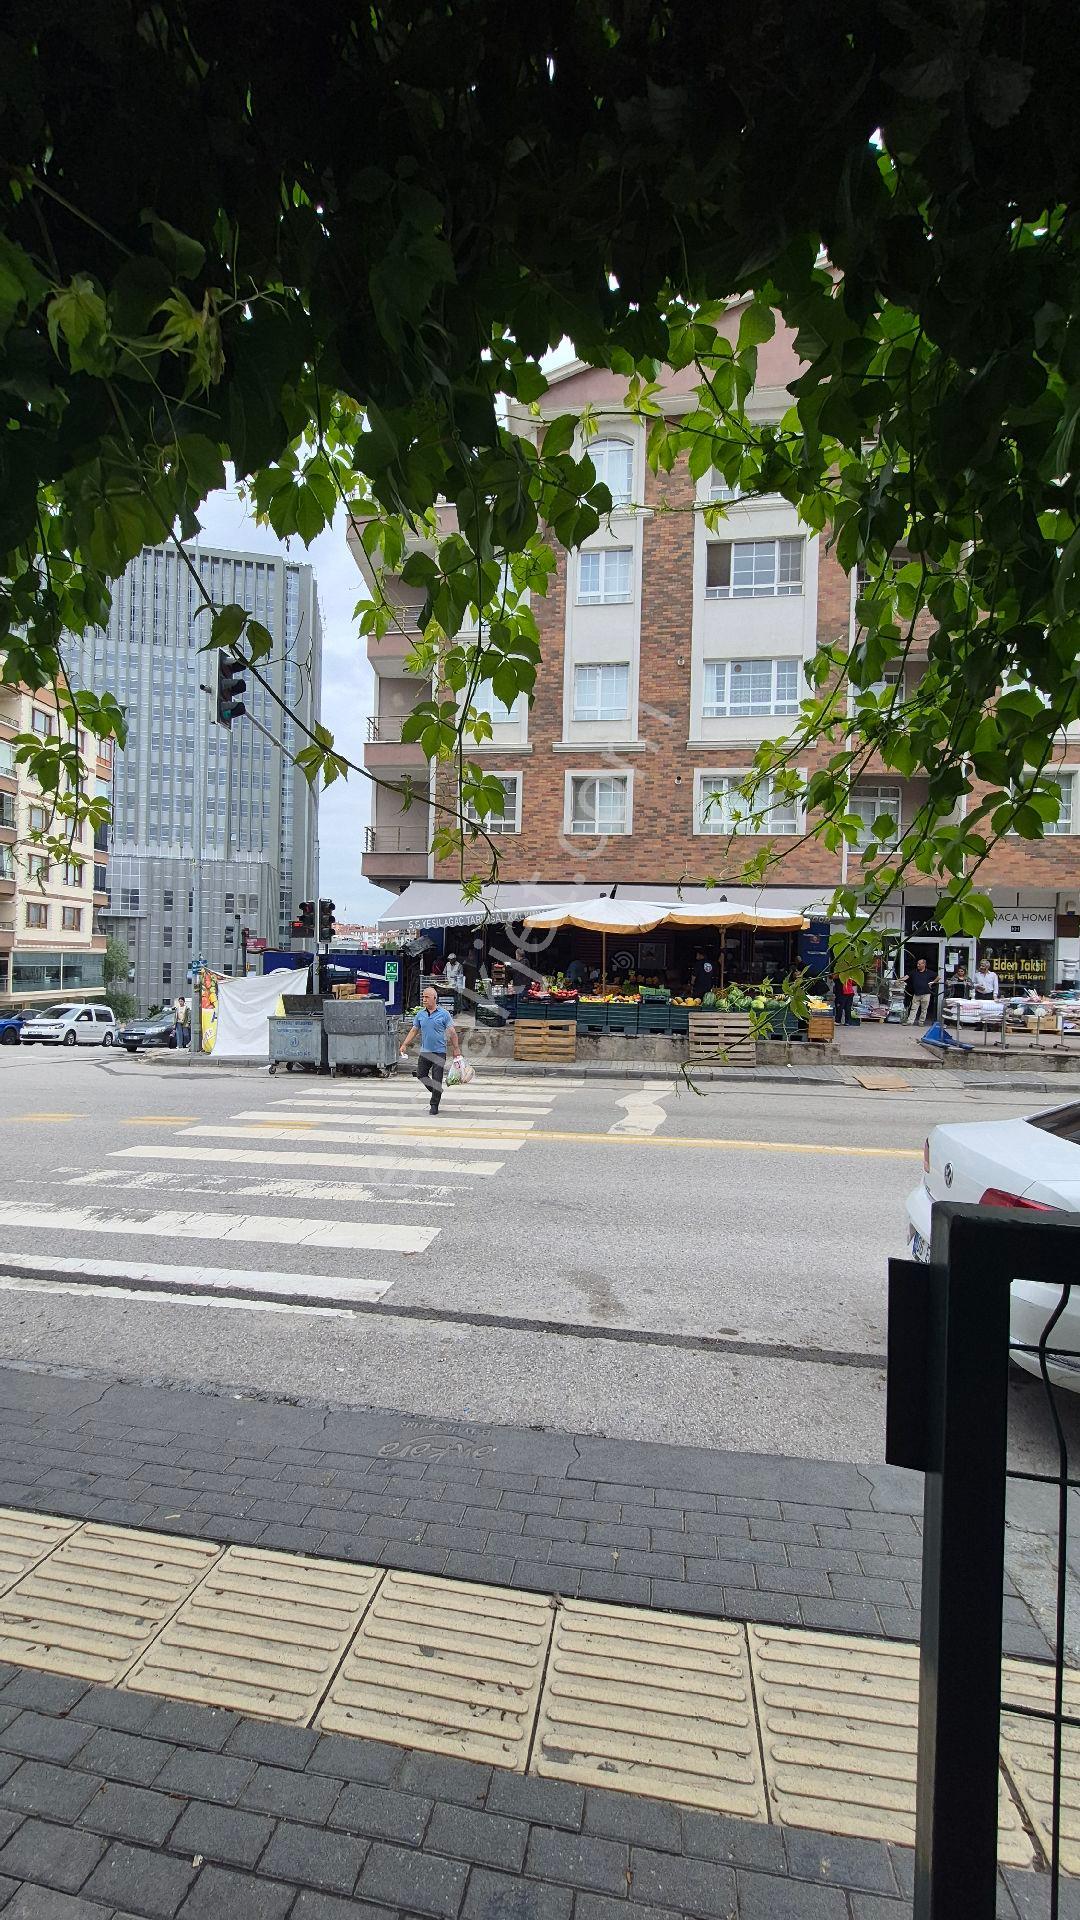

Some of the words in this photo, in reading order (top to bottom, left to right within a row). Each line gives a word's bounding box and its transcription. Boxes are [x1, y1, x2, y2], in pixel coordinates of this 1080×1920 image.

[994, 913, 1019, 922] RACA
[1021, 913, 1053, 922] HOME
[993, 957, 1018, 971] Elden
[1020, 959, 1046, 972] Taksit
